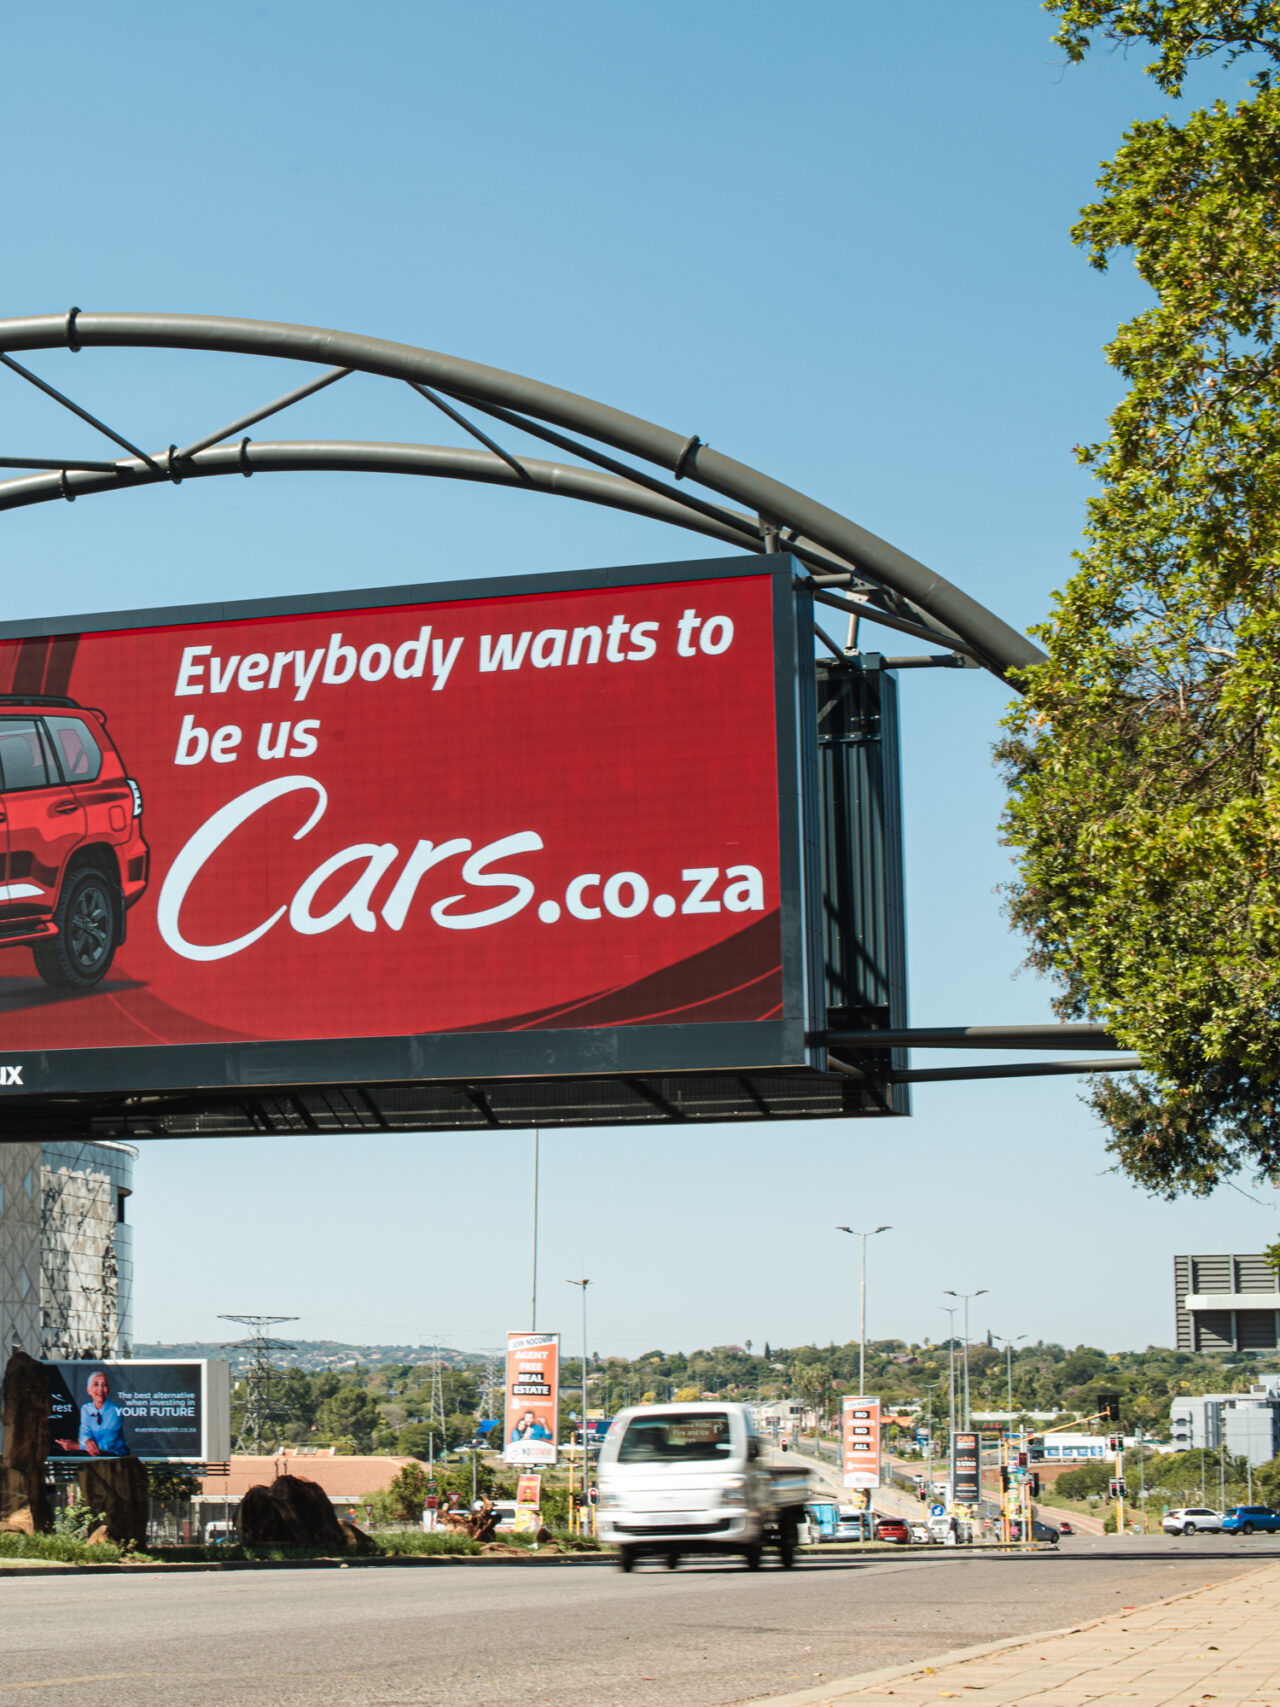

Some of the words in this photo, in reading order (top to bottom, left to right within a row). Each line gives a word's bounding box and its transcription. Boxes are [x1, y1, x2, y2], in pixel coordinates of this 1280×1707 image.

[175, 625, 466, 702] Everybody
[479, 614, 660, 674] wants
[677, 608, 734, 658] to
[175, 714, 242, 766] be
[257, 719, 322, 760] us
[157, 774, 766, 961] Cars.co.za
[514, 1350, 549, 1359] AGENT
[518, 1362, 543, 1371] FREE
[518, 1373, 544, 1383] REAL
[117, 1391, 132, 1399] The
[133, 1391, 151, 1399] best
[152, 1391, 196, 1399] alternative
[513, 1385, 550, 1395] ESTATE
[149, 1399, 186, 1407] investing
[115, 1407, 148, 1417] YOUR
[150, 1407, 196, 1417] FUTURE
